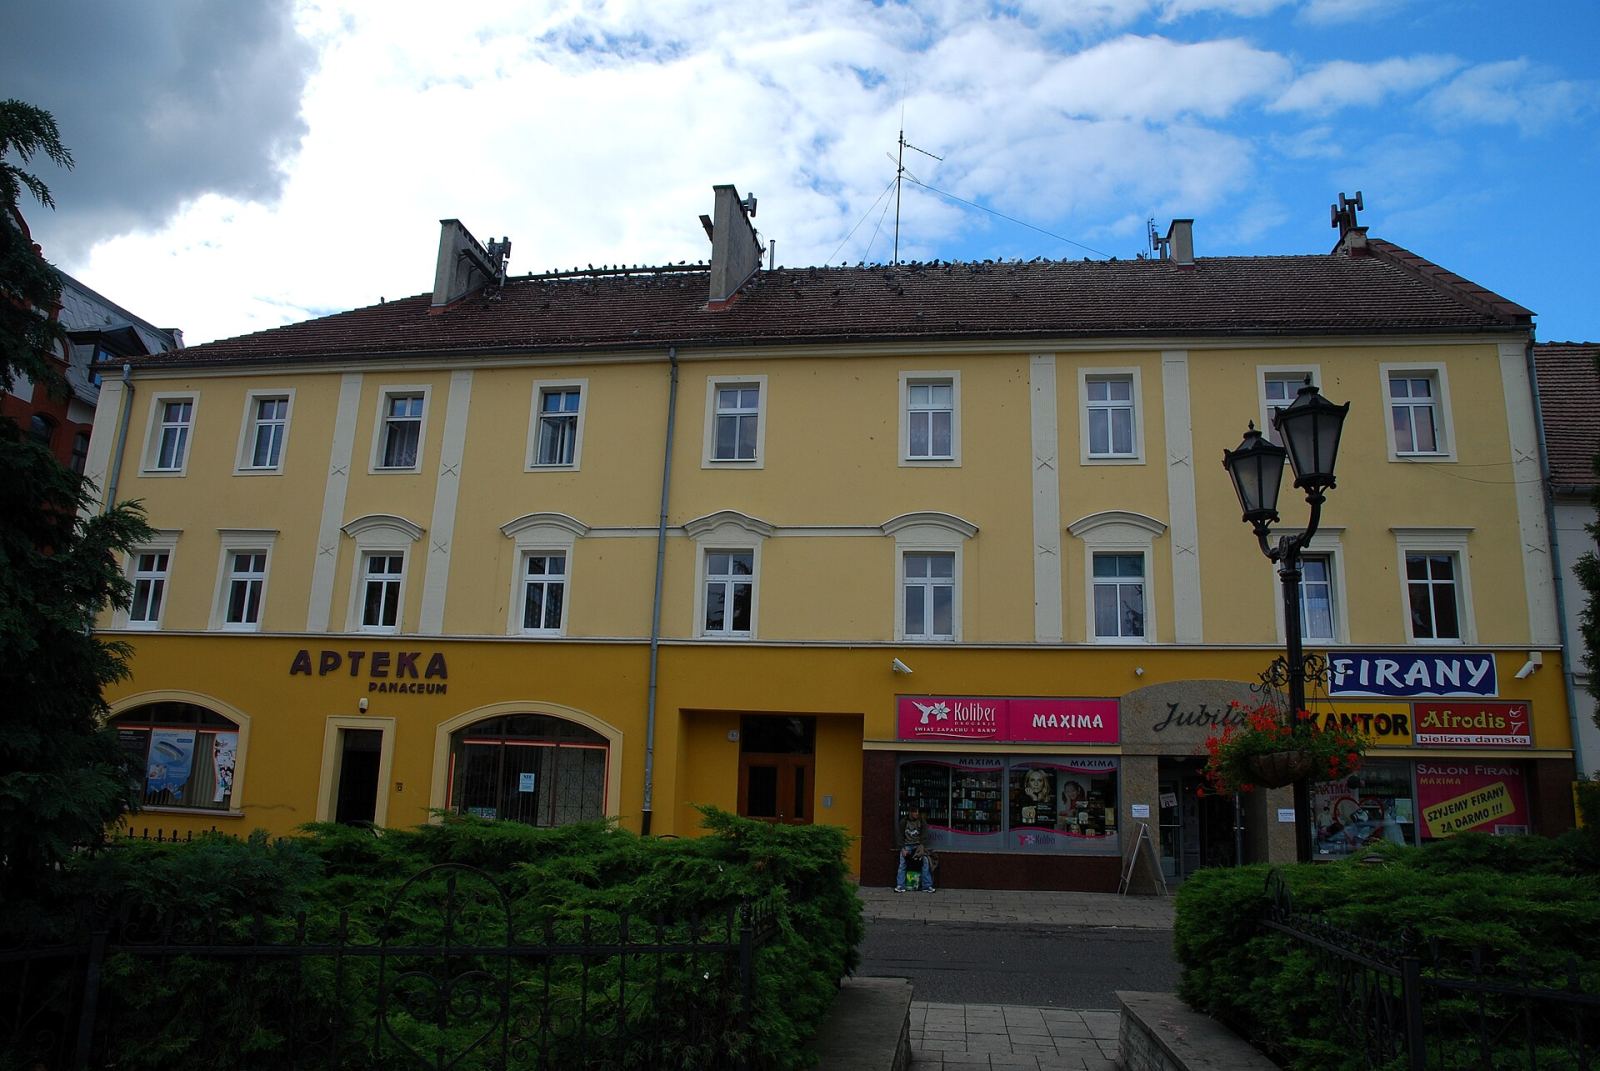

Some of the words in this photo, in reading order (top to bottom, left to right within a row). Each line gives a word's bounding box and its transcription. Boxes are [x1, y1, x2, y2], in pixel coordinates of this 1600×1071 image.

[289, 649, 448, 679] APTEKA
[1332, 658, 1490, 688] FIRANY
[368, 682, 448, 695] PANACEUM
[954, 702, 996, 722] Koliber
[1420, 710, 1506, 729] Afrodis
[1032, 713, 1104, 729] MAXIMA
[1420, 735, 1471, 743] bielizna
[1475, 735, 1527, 744] damska
[959, 758, 1001, 766] MAXIMA
[1070, 760, 1114, 768] MAXIMA
[1419, 776, 1461, 785] MAXIMA
[1427, 799, 1469, 822] SZYJEMY
[1471, 785, 1505, 807] FIRANY
[1440, 822, 1454, 834] ZA
[1455, 809, 1490, 830] DARMO
